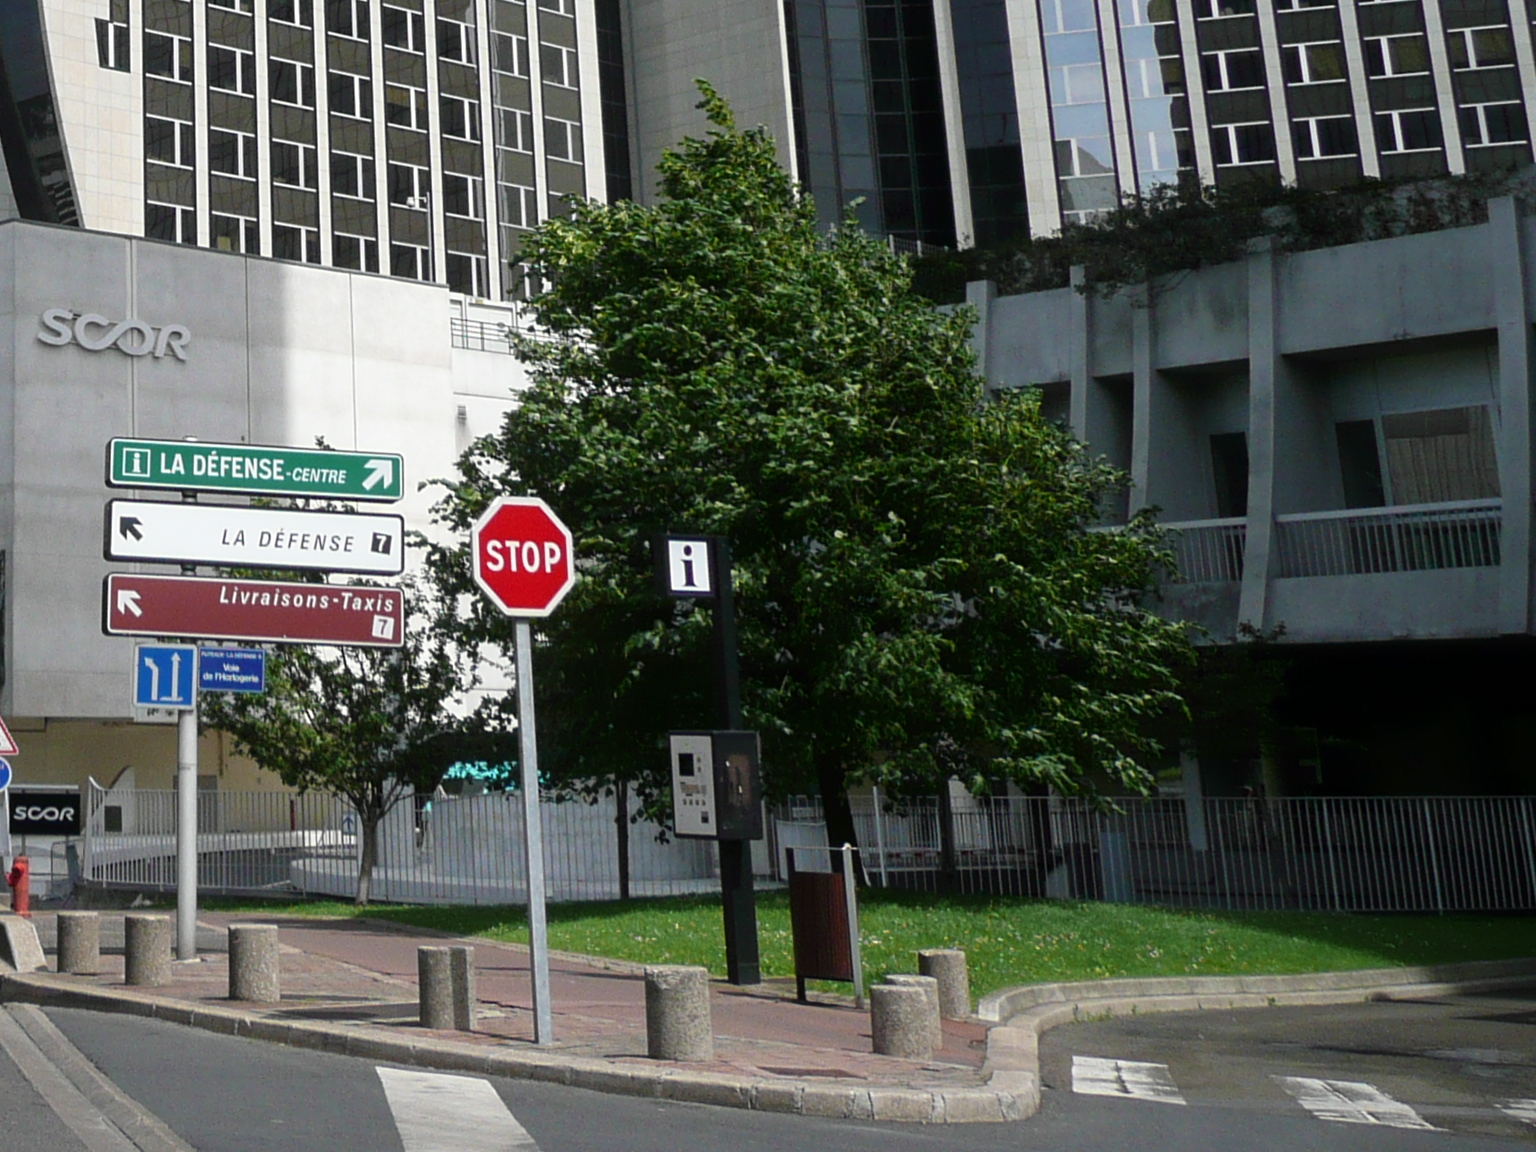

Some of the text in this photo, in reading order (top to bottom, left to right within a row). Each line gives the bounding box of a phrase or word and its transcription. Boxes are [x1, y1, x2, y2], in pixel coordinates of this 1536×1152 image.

[37, 308, 192, 363] SCOR
[160, 452, 186, 475] LA
[221, 528, 387, 552] LA DÉFENSE 7
[486, 539, 561, 573] STOP
[378, 619, 388, 635] 7
[222, 663, 240, 672] Voie
[202, 672, 259, 684] de l'Horlogerie
[13, 806, 75, 822] SCOR
